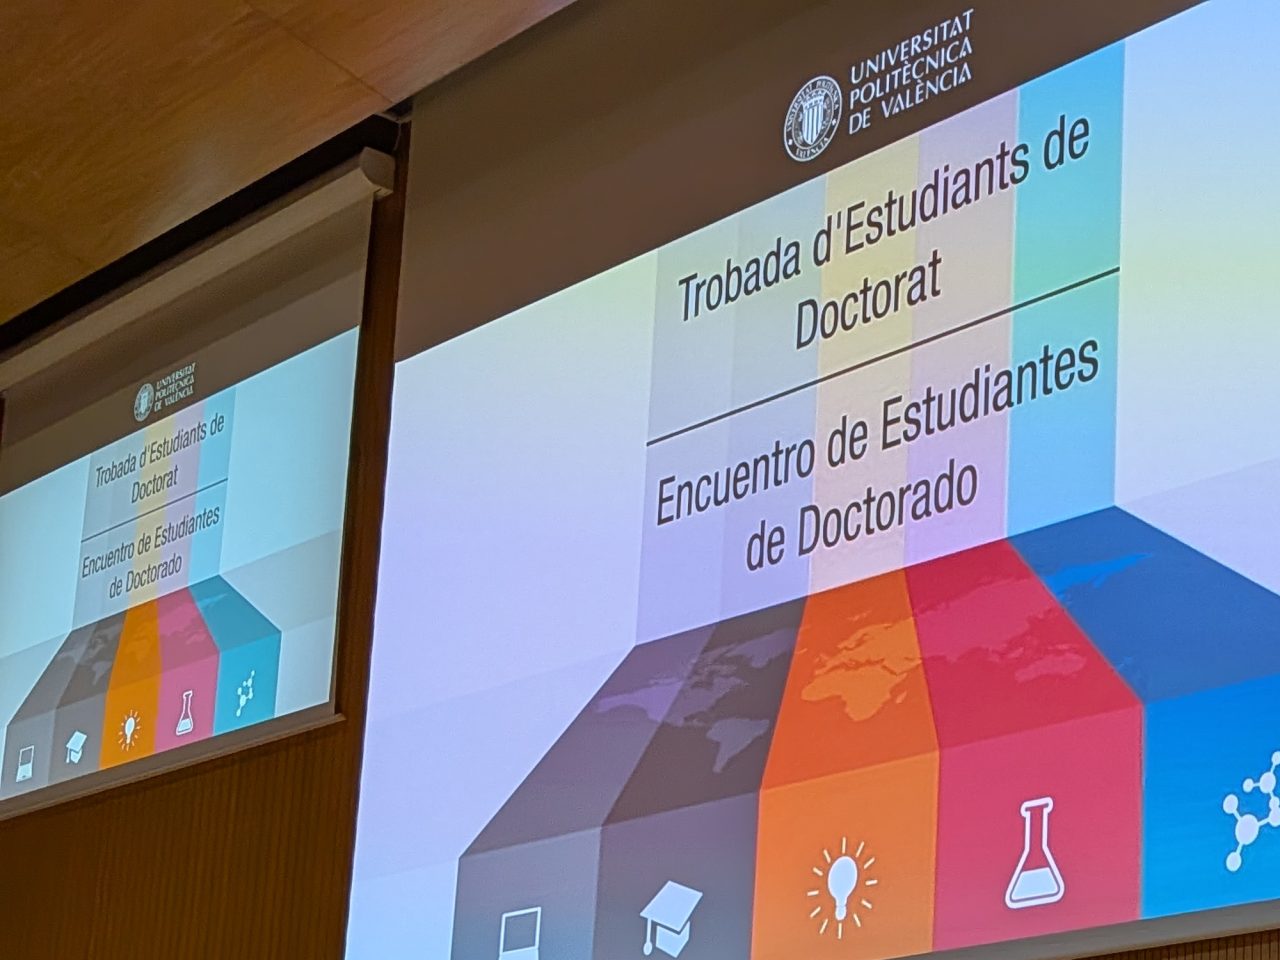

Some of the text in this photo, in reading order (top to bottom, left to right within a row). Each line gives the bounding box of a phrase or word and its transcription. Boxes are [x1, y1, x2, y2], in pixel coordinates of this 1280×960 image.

[850, 36, 972, 109] POLITÈCNICA
[851, 9, 974, 84] UNIVERSITAT
[849, 62, 972, 134] DE VALÈNCIA
[679, 115, 1090, 322] Trobada d'Estudiants de
[796, 250, 942, 349] Doctorat
[96, 413, 225, 488] Trobada d'Estudiants de
[656, 338, 1099, 525] Encuentro de Estudiantes
[131, 465, 178, 504] Doctorat
[747, 458, 977, 572] de Doctorado
[82, 506, 220, 578] Encuentro de Estudiantes
[109, 553, 182, 599] de Doctorado
